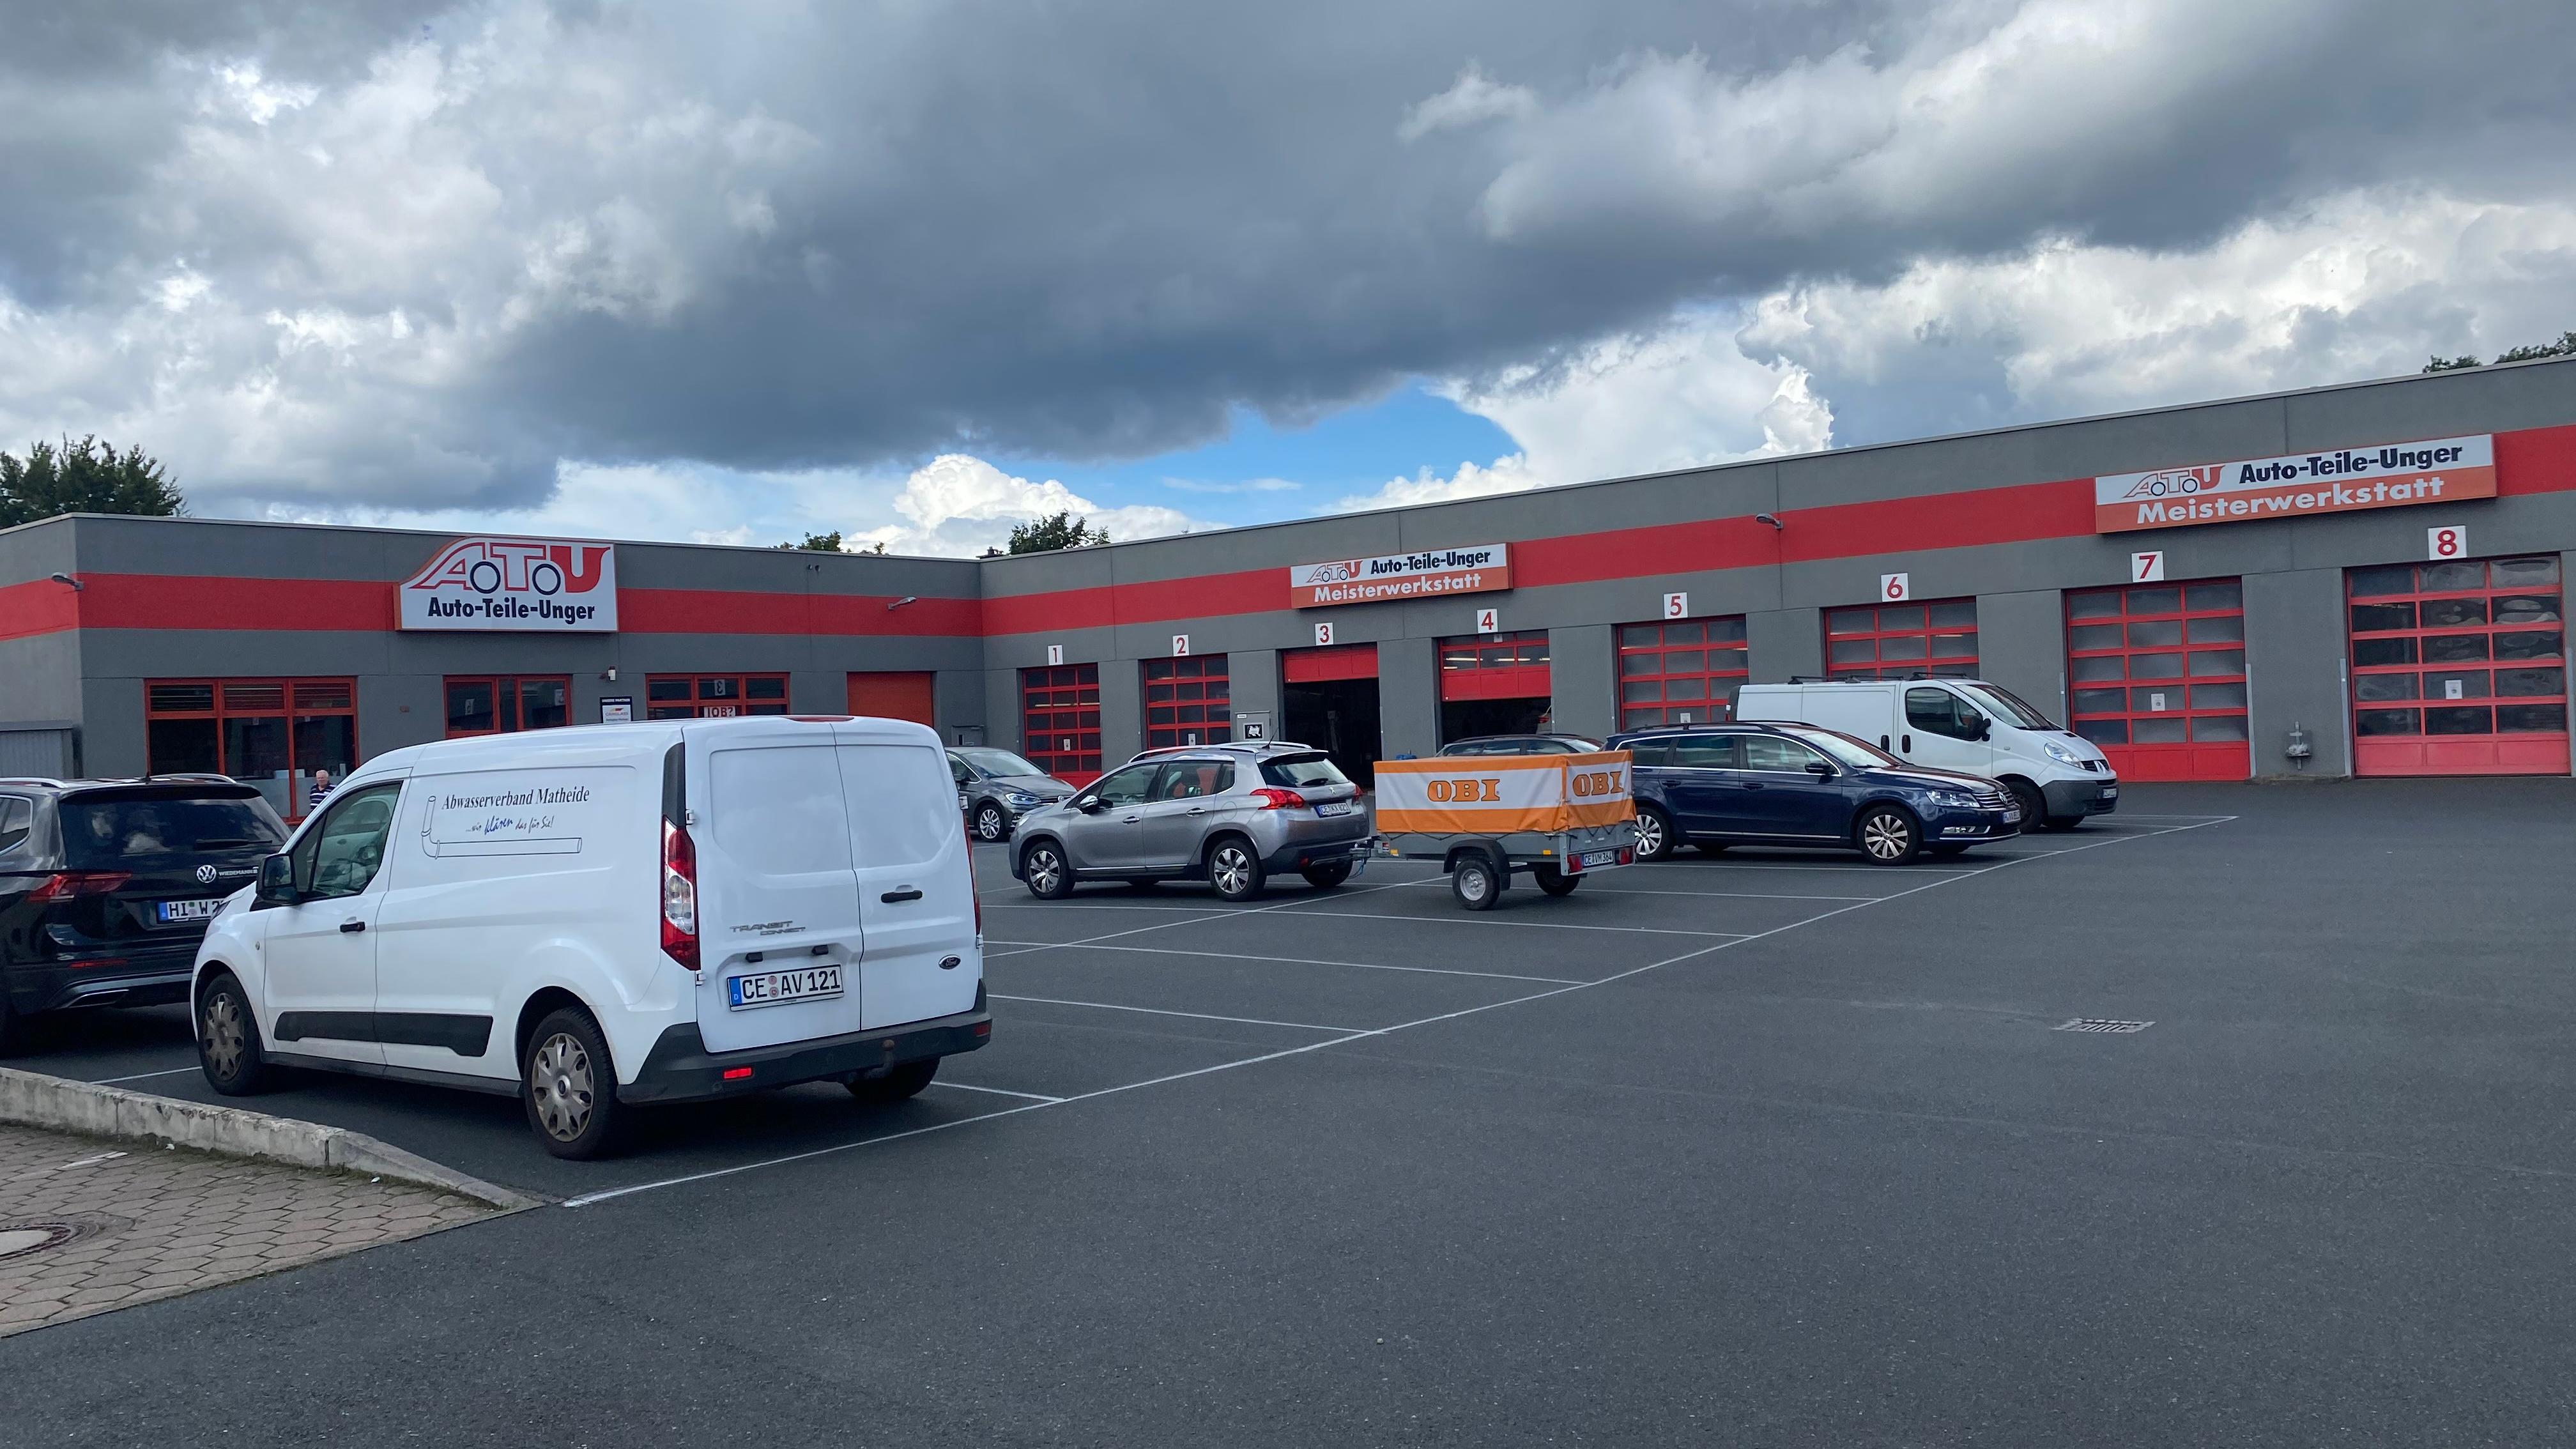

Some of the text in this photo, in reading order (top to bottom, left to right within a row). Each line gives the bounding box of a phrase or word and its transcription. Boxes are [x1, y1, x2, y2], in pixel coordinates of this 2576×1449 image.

[2239, 445, 2463, 484] Auto-Teile-Unger
[2136, 477, 2445, 525] Meisterwerkstatt
[2437, 530, 2458, 556] 8
[1370, 551, 1491, 575] Auto-Teile-Unger
[2138, 555, 2158, 579] 7
[1314, 573, 1482, 603] Meisterwerkstatt
[1886, 576, 1904, 599] 6
[427, 597, 595, 625] Auto-Teile-Unger
[1670, 595, 1683, 617] 5
[1481, 611, 1494, 631] 4
[1176, 637, 1186, 654] 2
[1319, 625, 1330, 643] 3
[1052, 647, 1058, 663] 1
[1427, 779, 1501, 802] OBI
[1572, 770, 1625, 797] OBI
[441, 786, 590, 810] Abwasserverband Matheide
[484, 815, 513, 836] klären
[515, 818, 527, 831] das
[528, 817, 540, 834] für
[540, 815, 555, 829] Sie!
[1584, 854, 1592, 865] CE
[169, 903, 188, 917] HI
[199, 901, 208, 915] W
[730, 920, 793, 933] TRANSIT
[742, 970, 840, 999] CE AV 121
[733, 993, 739, 1001] D
